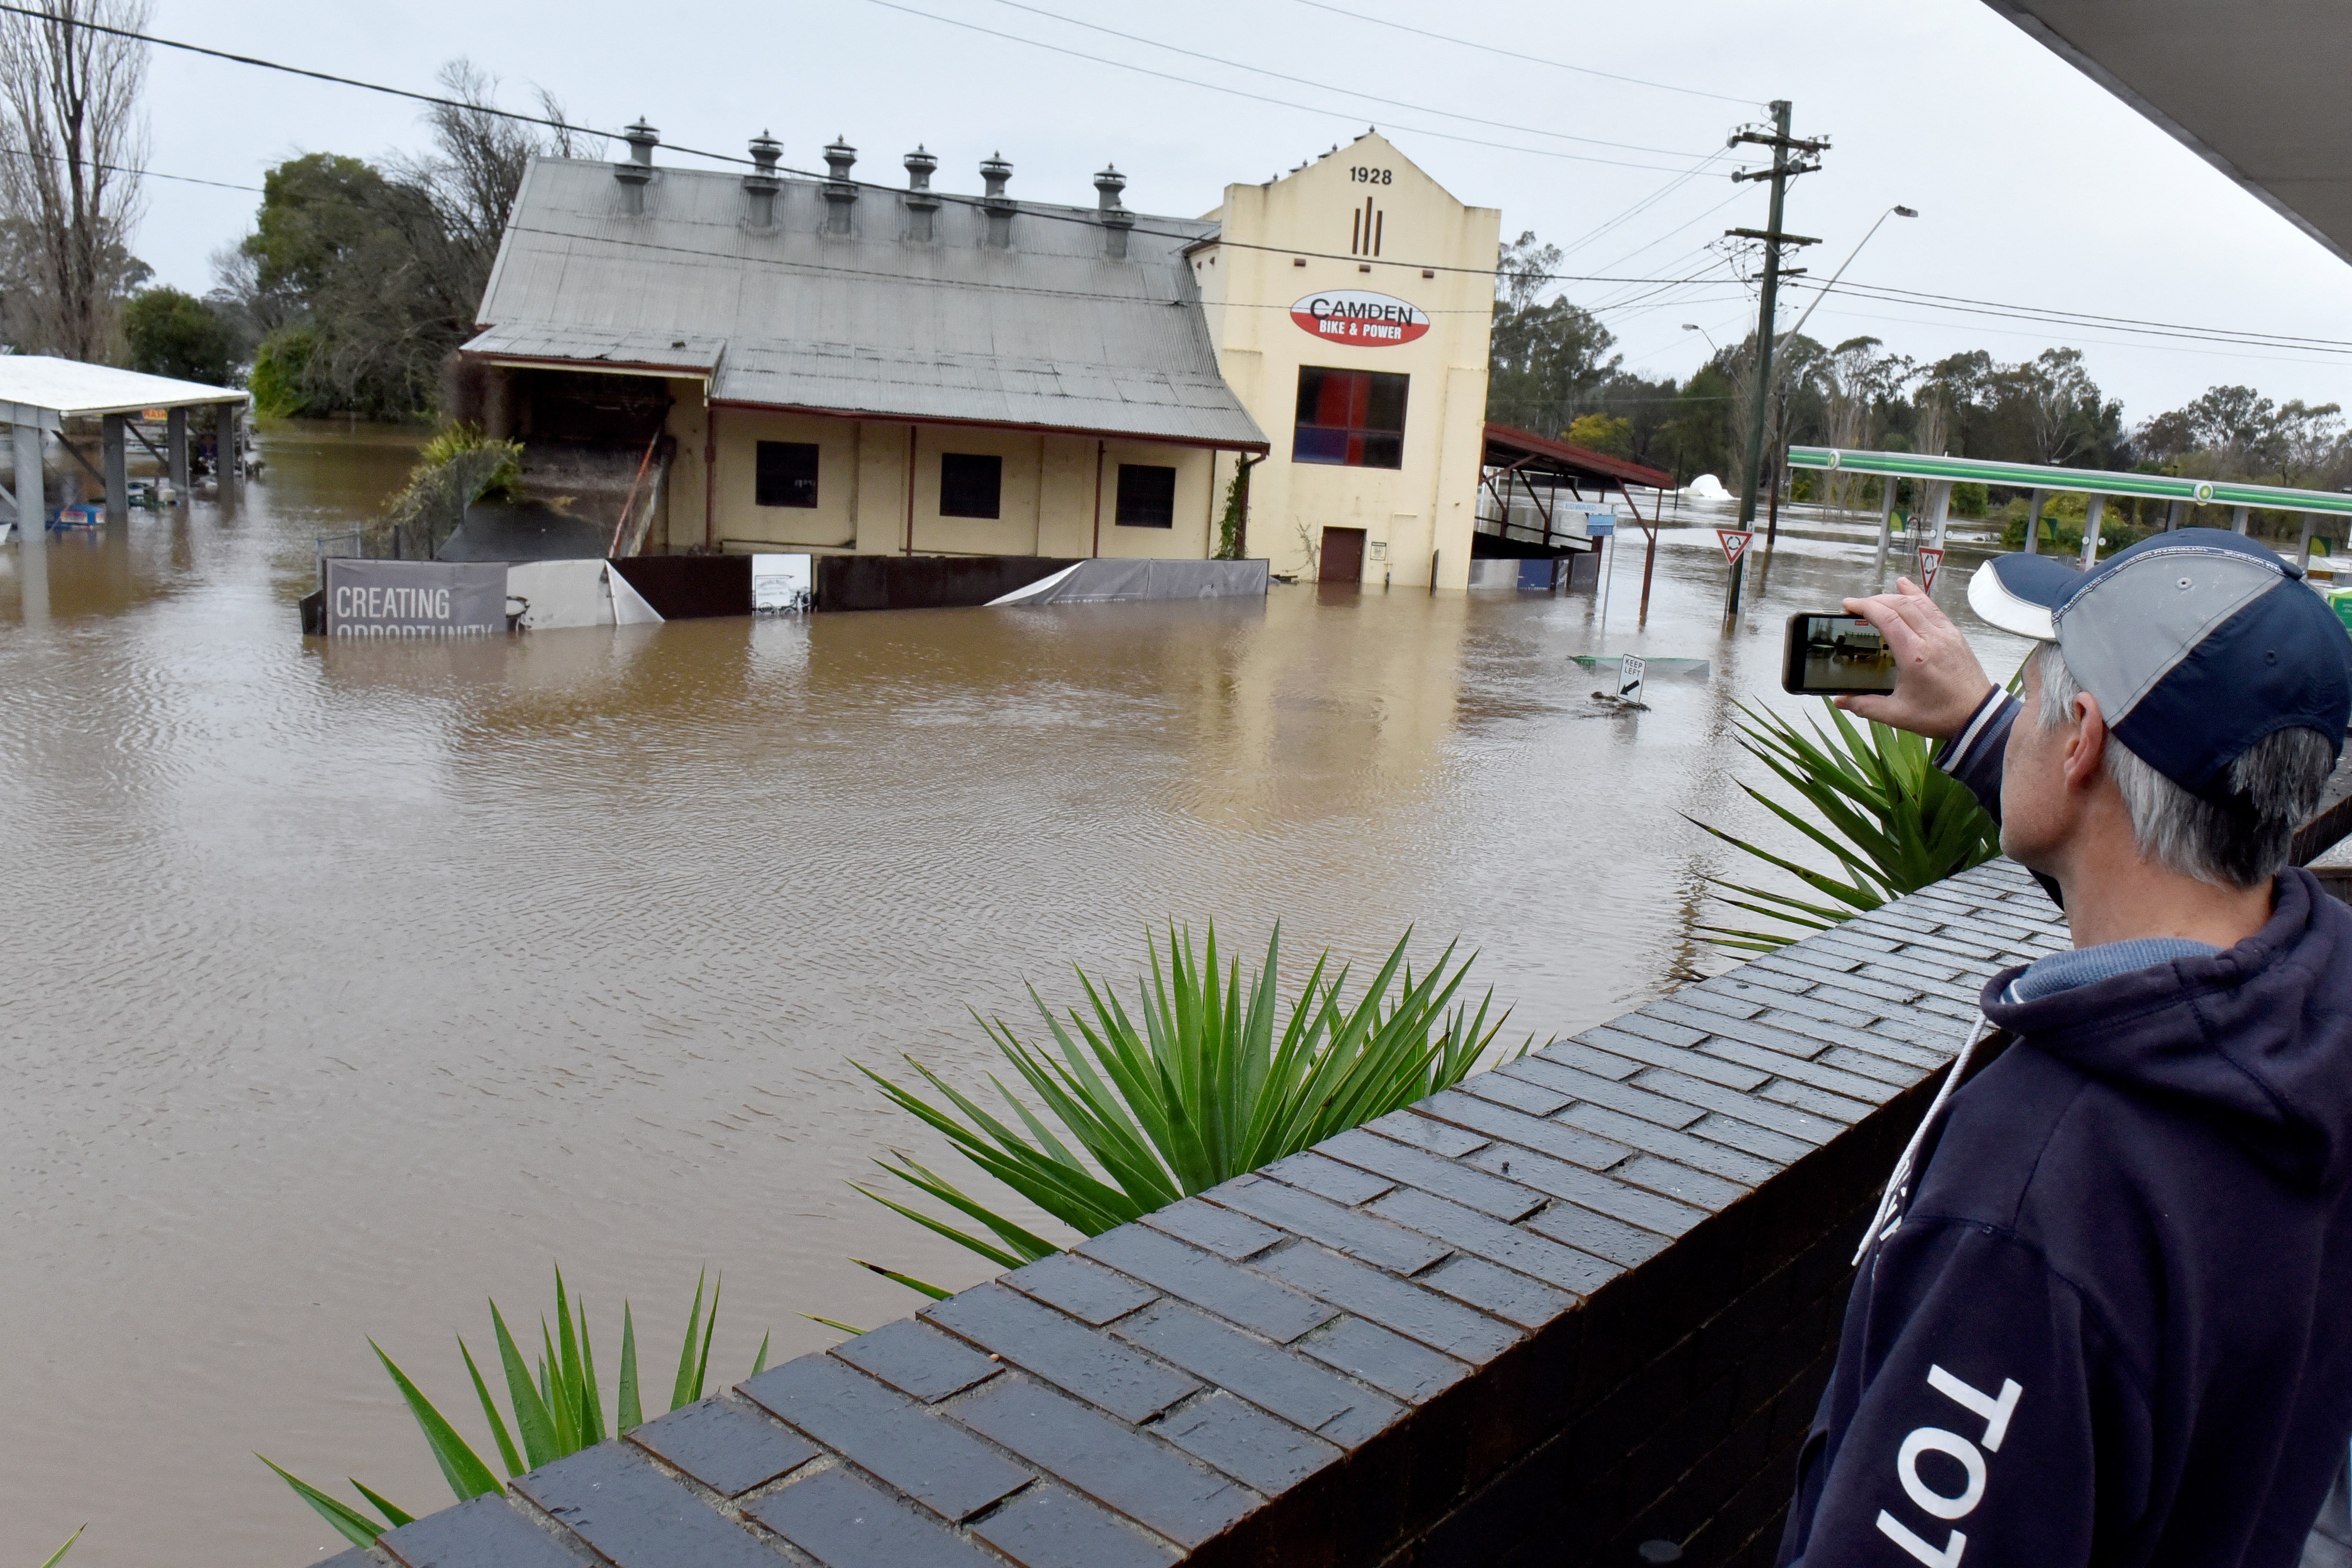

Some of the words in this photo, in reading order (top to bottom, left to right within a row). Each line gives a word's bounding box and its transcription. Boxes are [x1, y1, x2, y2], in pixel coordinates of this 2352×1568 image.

[1350, 166, 1392, 185] 1928
[1310, 298, 1413, 326] CAMDEN
[1319, 320, 1345, 334] BIKE
[1349, 322, 1357, 335] &
[1362, 323, 1402, 339] POWER
[337, 586, 450, 619] CREATING
[1625, 658, 1643, 669] KEEP
[1625, 667, 1641, 677] LEFT
